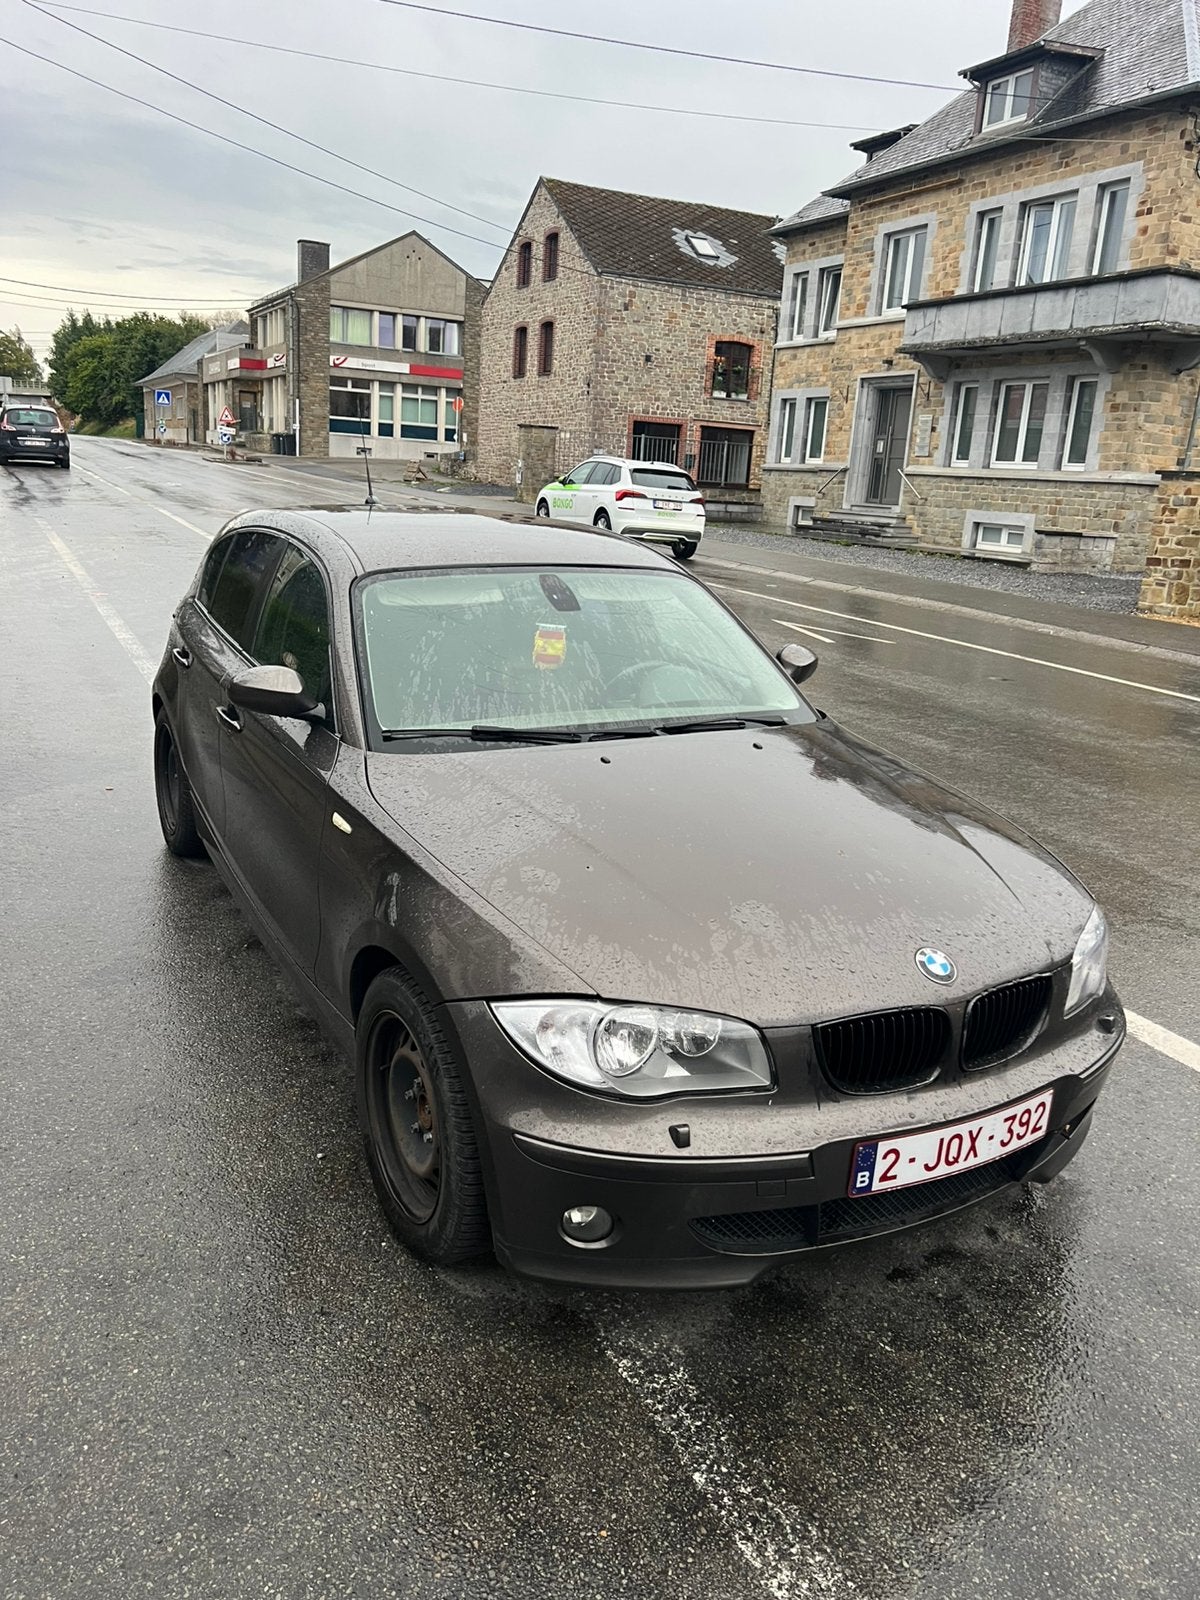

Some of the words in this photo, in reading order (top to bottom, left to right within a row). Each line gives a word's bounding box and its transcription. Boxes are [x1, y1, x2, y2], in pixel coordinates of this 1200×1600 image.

[552, 497, 573, 509] BONGO
[878, 1101, 1047, 1184] 2-JQX-392
[855, 1171, 870, 1188] B
